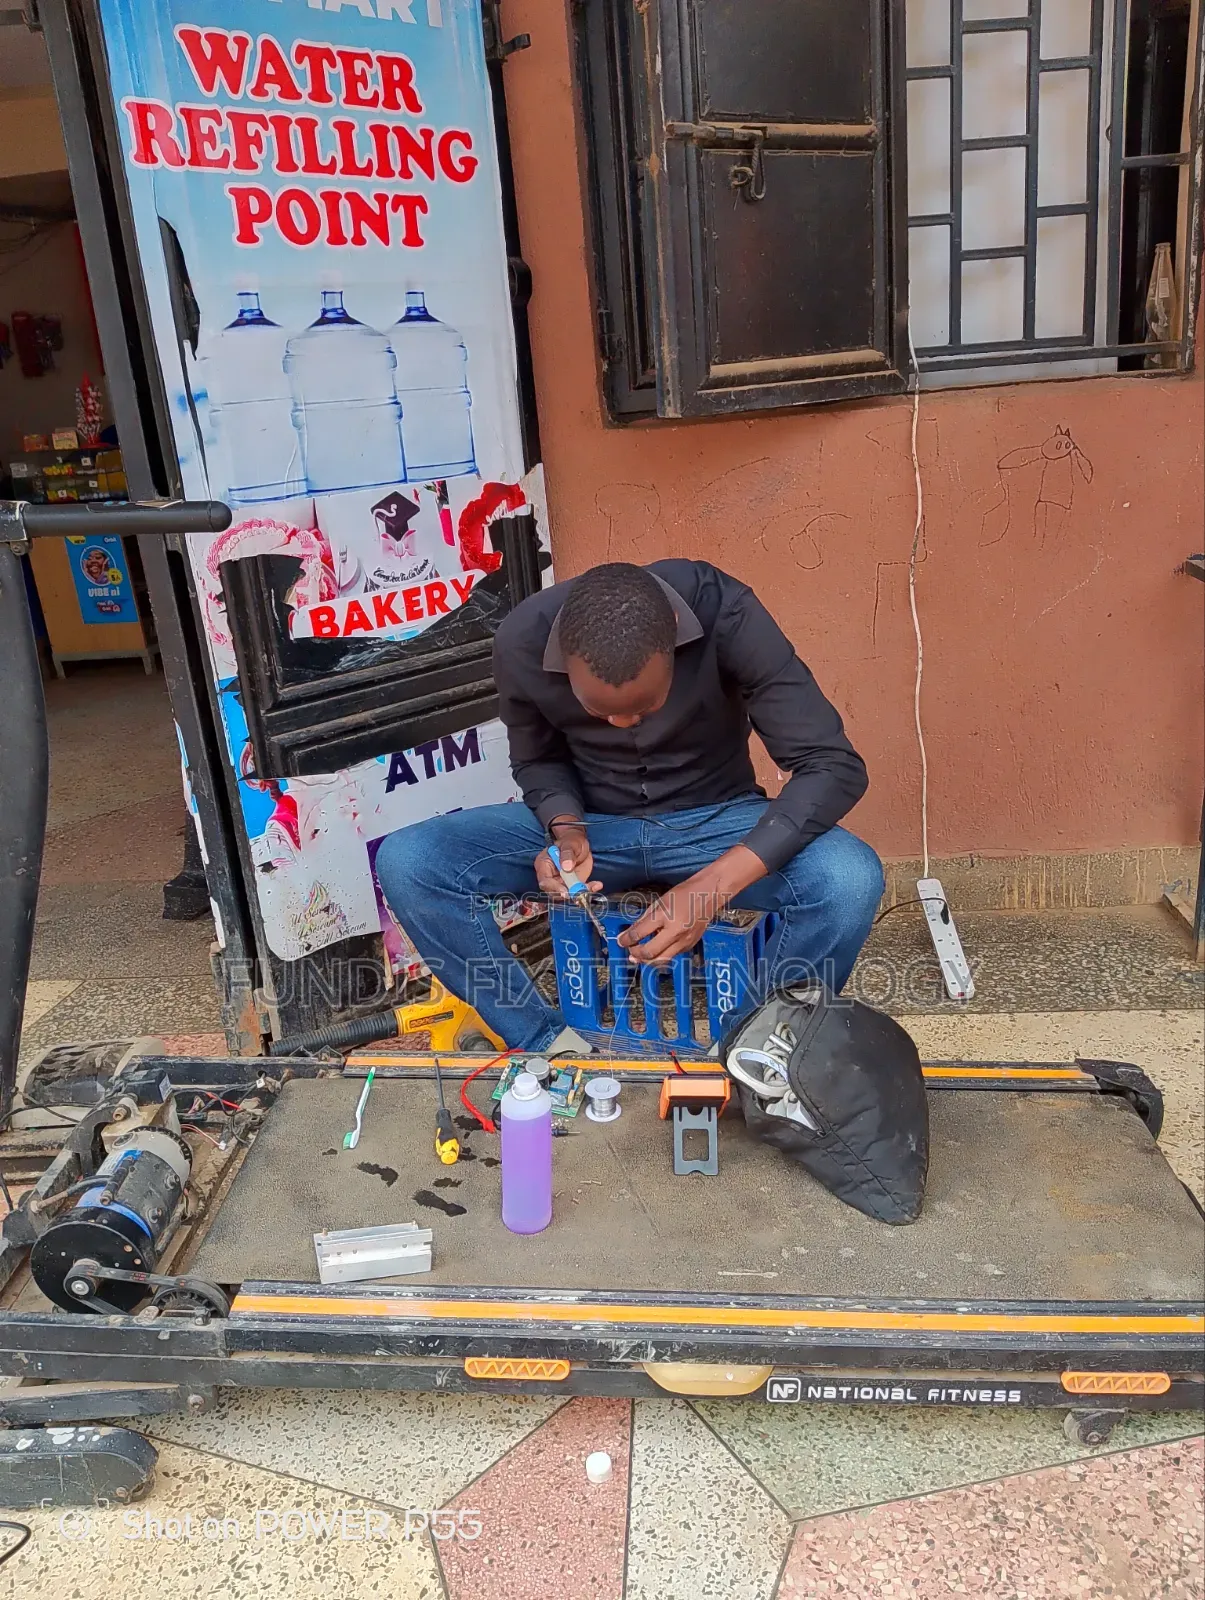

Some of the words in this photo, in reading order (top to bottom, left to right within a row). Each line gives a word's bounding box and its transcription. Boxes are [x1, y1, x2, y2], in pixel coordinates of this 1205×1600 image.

[176, 26, 424, 115] WATER
[124, 98, 480, 184] REFILLING
[226, 185, 430, 248] POINT
[308, 574, 476, 638] BAKERY
[385, 727, 482, 794] ATM
[560, 938, 588, 1009] pepsi
[716, 960, 732, 1024] epsi
